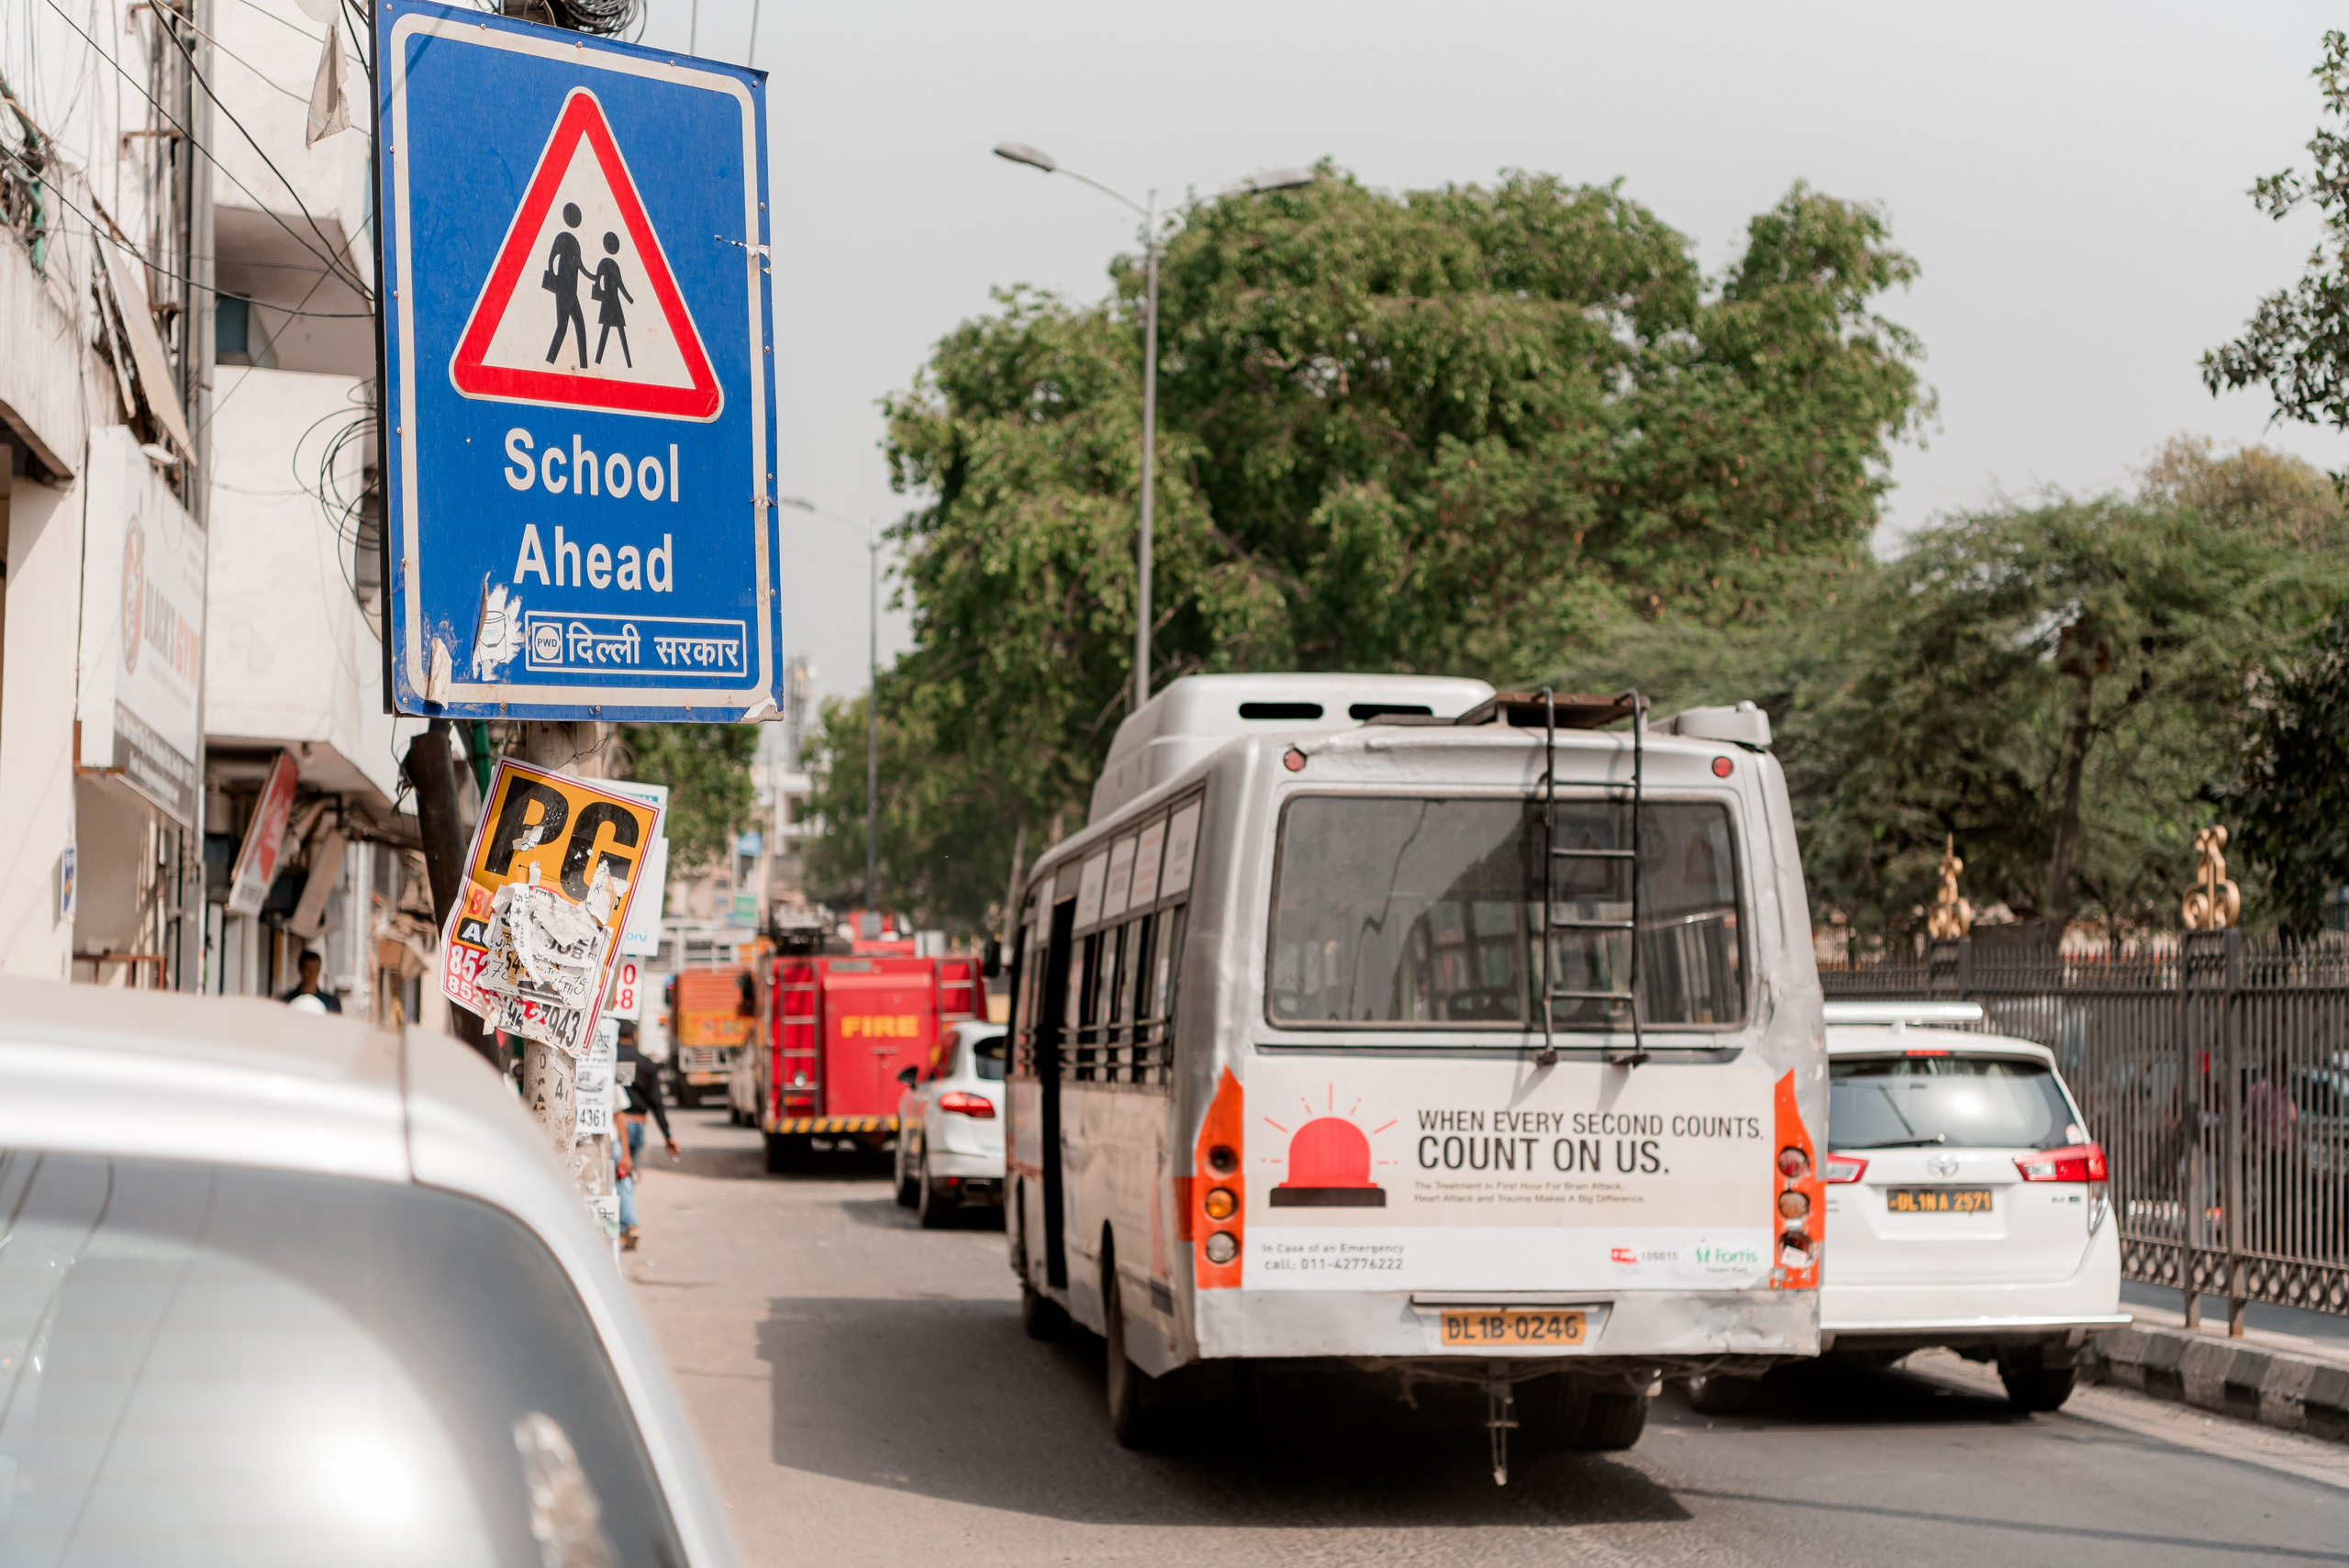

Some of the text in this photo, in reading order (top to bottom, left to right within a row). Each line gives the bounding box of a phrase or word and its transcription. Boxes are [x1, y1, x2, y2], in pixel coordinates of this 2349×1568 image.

[505, 428, 679, 502] School
[513, 523, 673, 592] Ahead
[537, 638, 558, 648] PWD
[566, 622, 739, 666] दिल्ली सरकार
[484, 775, 639, 903] PG
[841, 1015, 919, 1038] FIRE
[1418, 1109, 1765, 1141] WHEN EVERY SECOND COUNTS,
[1418, 1136, 1670, 1174] COUNT ON US.
[1435, 1181, 1483, 1190] Treatment
[1443, 1195, 1473, 1204] Attack
[1263, 1243, 1406, 1256] In Case of an Emergency
[1715, 1247, 1759, 1263] Fortis
[1300, 1259, 1404, 1271] 011-42776222
